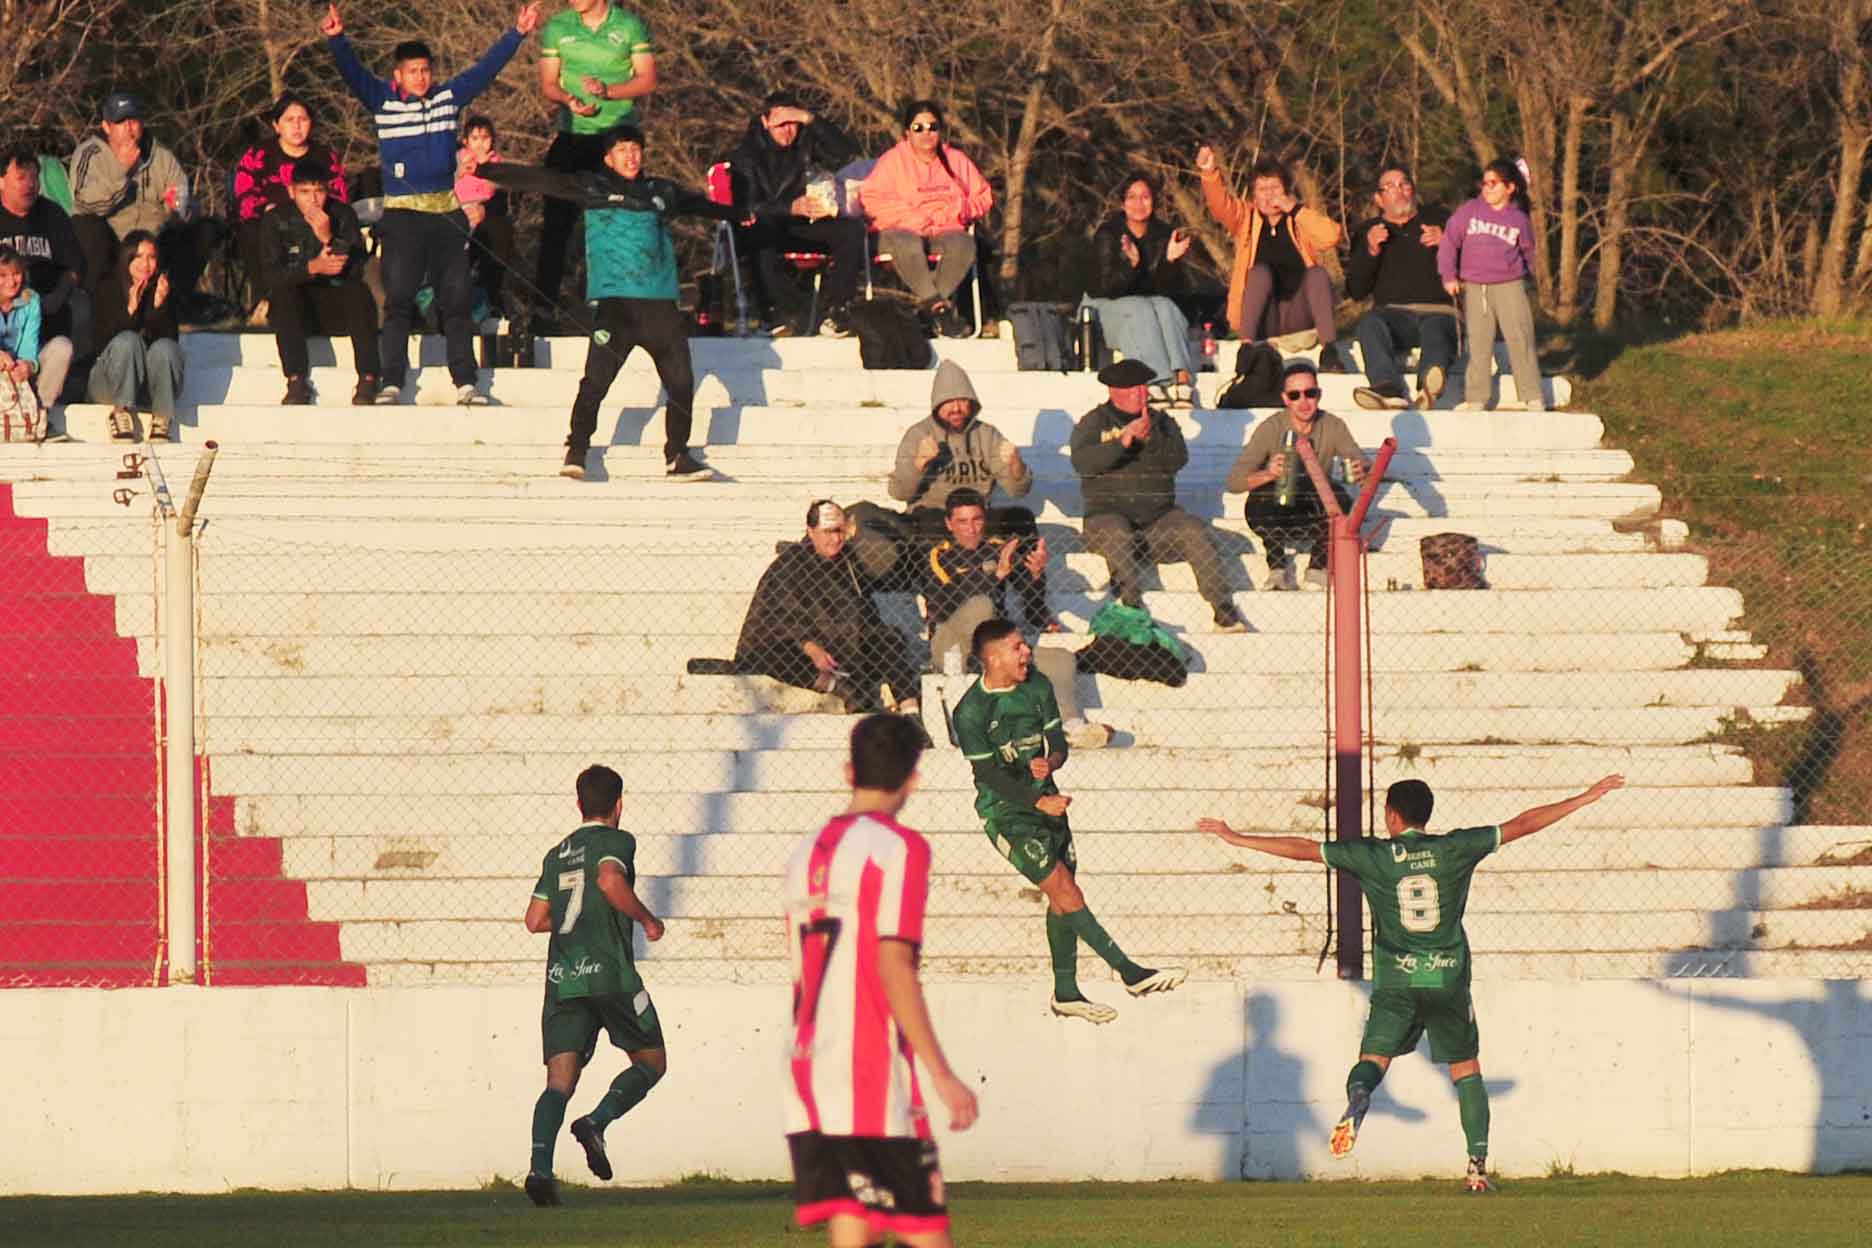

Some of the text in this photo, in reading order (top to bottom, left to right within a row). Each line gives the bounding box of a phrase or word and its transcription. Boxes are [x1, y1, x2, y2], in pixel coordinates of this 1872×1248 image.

[1467, 217, 1520, 247] SMILE
[558, 868, 585, 934] 7
[1396, 873, 1441, 933] 8
[548, 962, 564, 984] La
[1394, 953, 1418, 974] La
